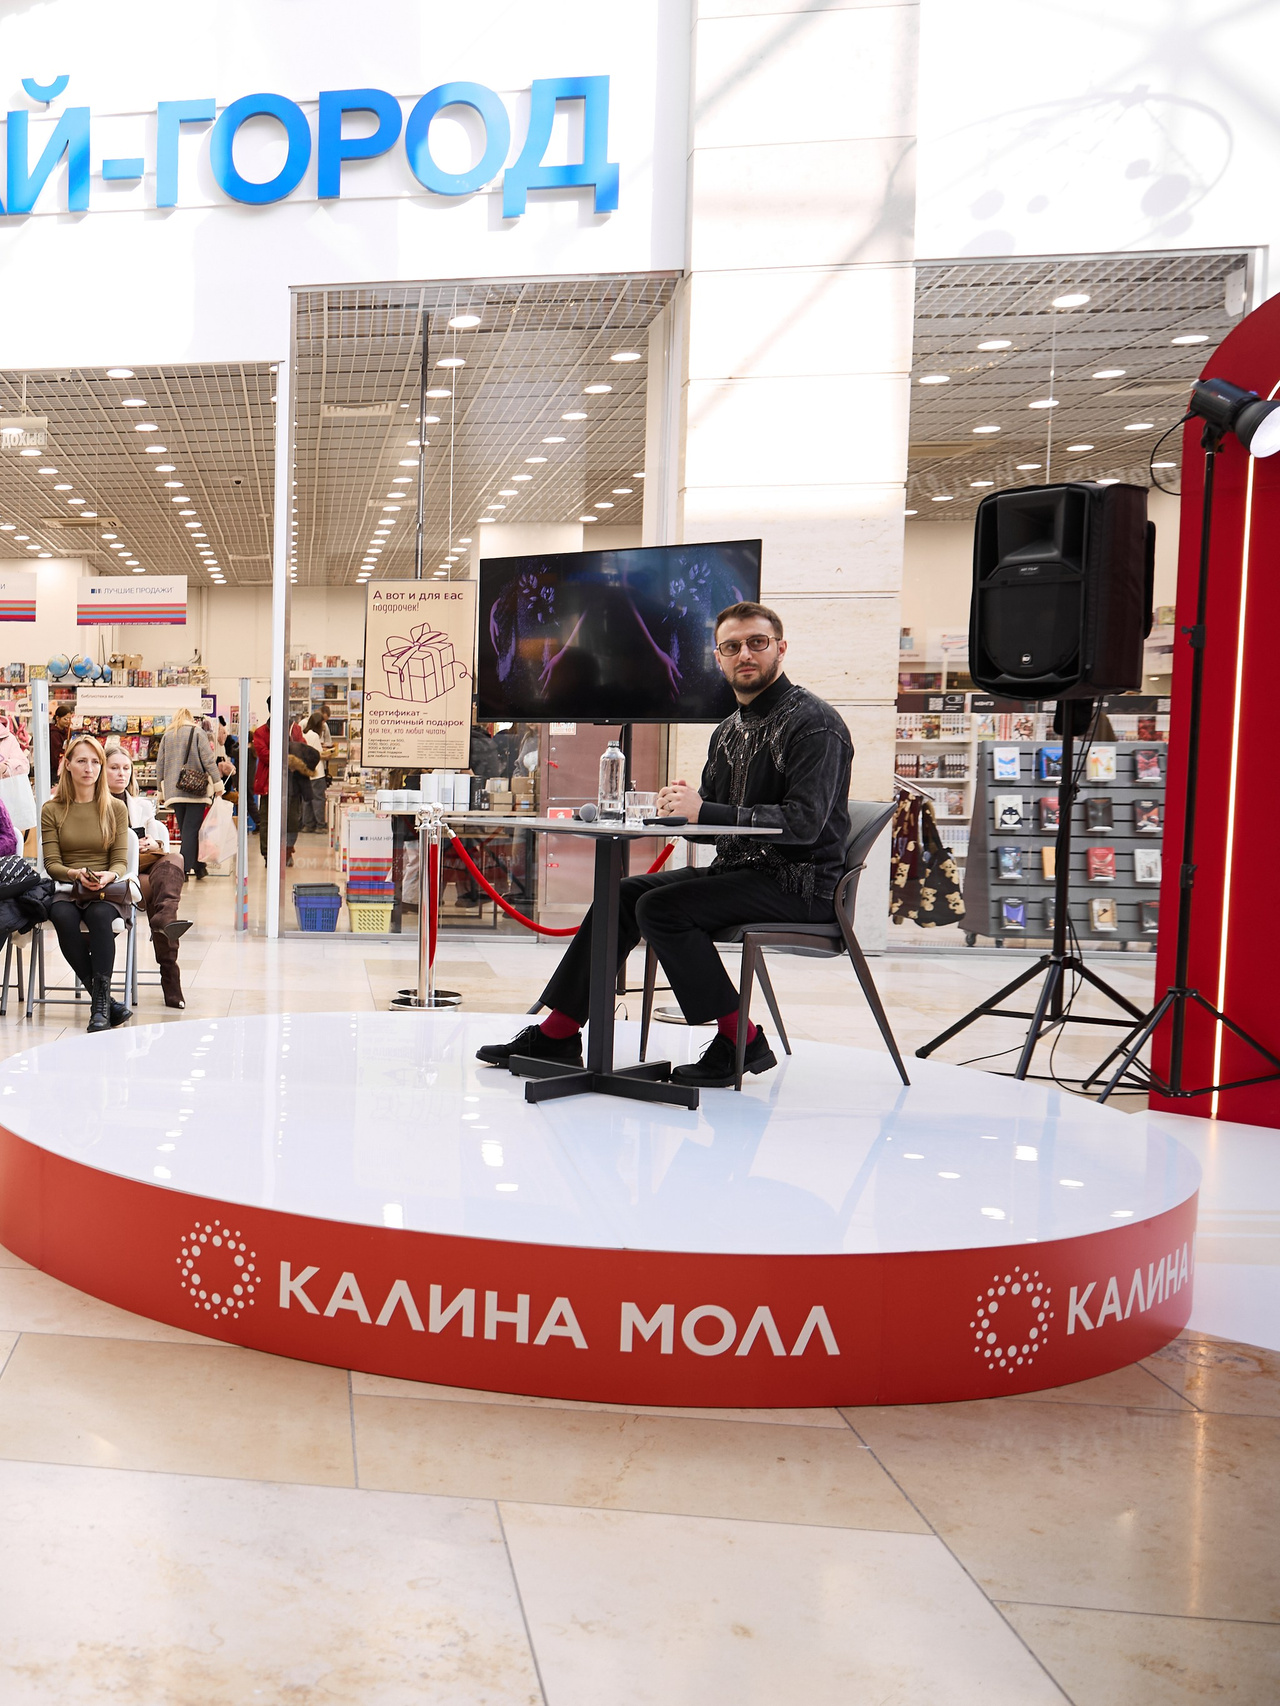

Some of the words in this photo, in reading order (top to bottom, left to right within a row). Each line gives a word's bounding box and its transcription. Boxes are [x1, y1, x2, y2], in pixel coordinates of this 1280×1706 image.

[373, 590, 382, 600] А
[386, 592, 405, 600] вот
[409, 592, 416, 600] и
[419, 592, 440, 601] для
[372, 602, 419, 614] подарочек!
[368, 709, 420, 718] сертификат
[380, 718, 424, 726] отличный
[426, 720, 464, 728] подарок
[1066, 1241, 1188, 1336] КАЛИНА
[279, 1260, 589, 1349] КАЛИНА
[619, 1301, 841, 1357] МОЛЛ
